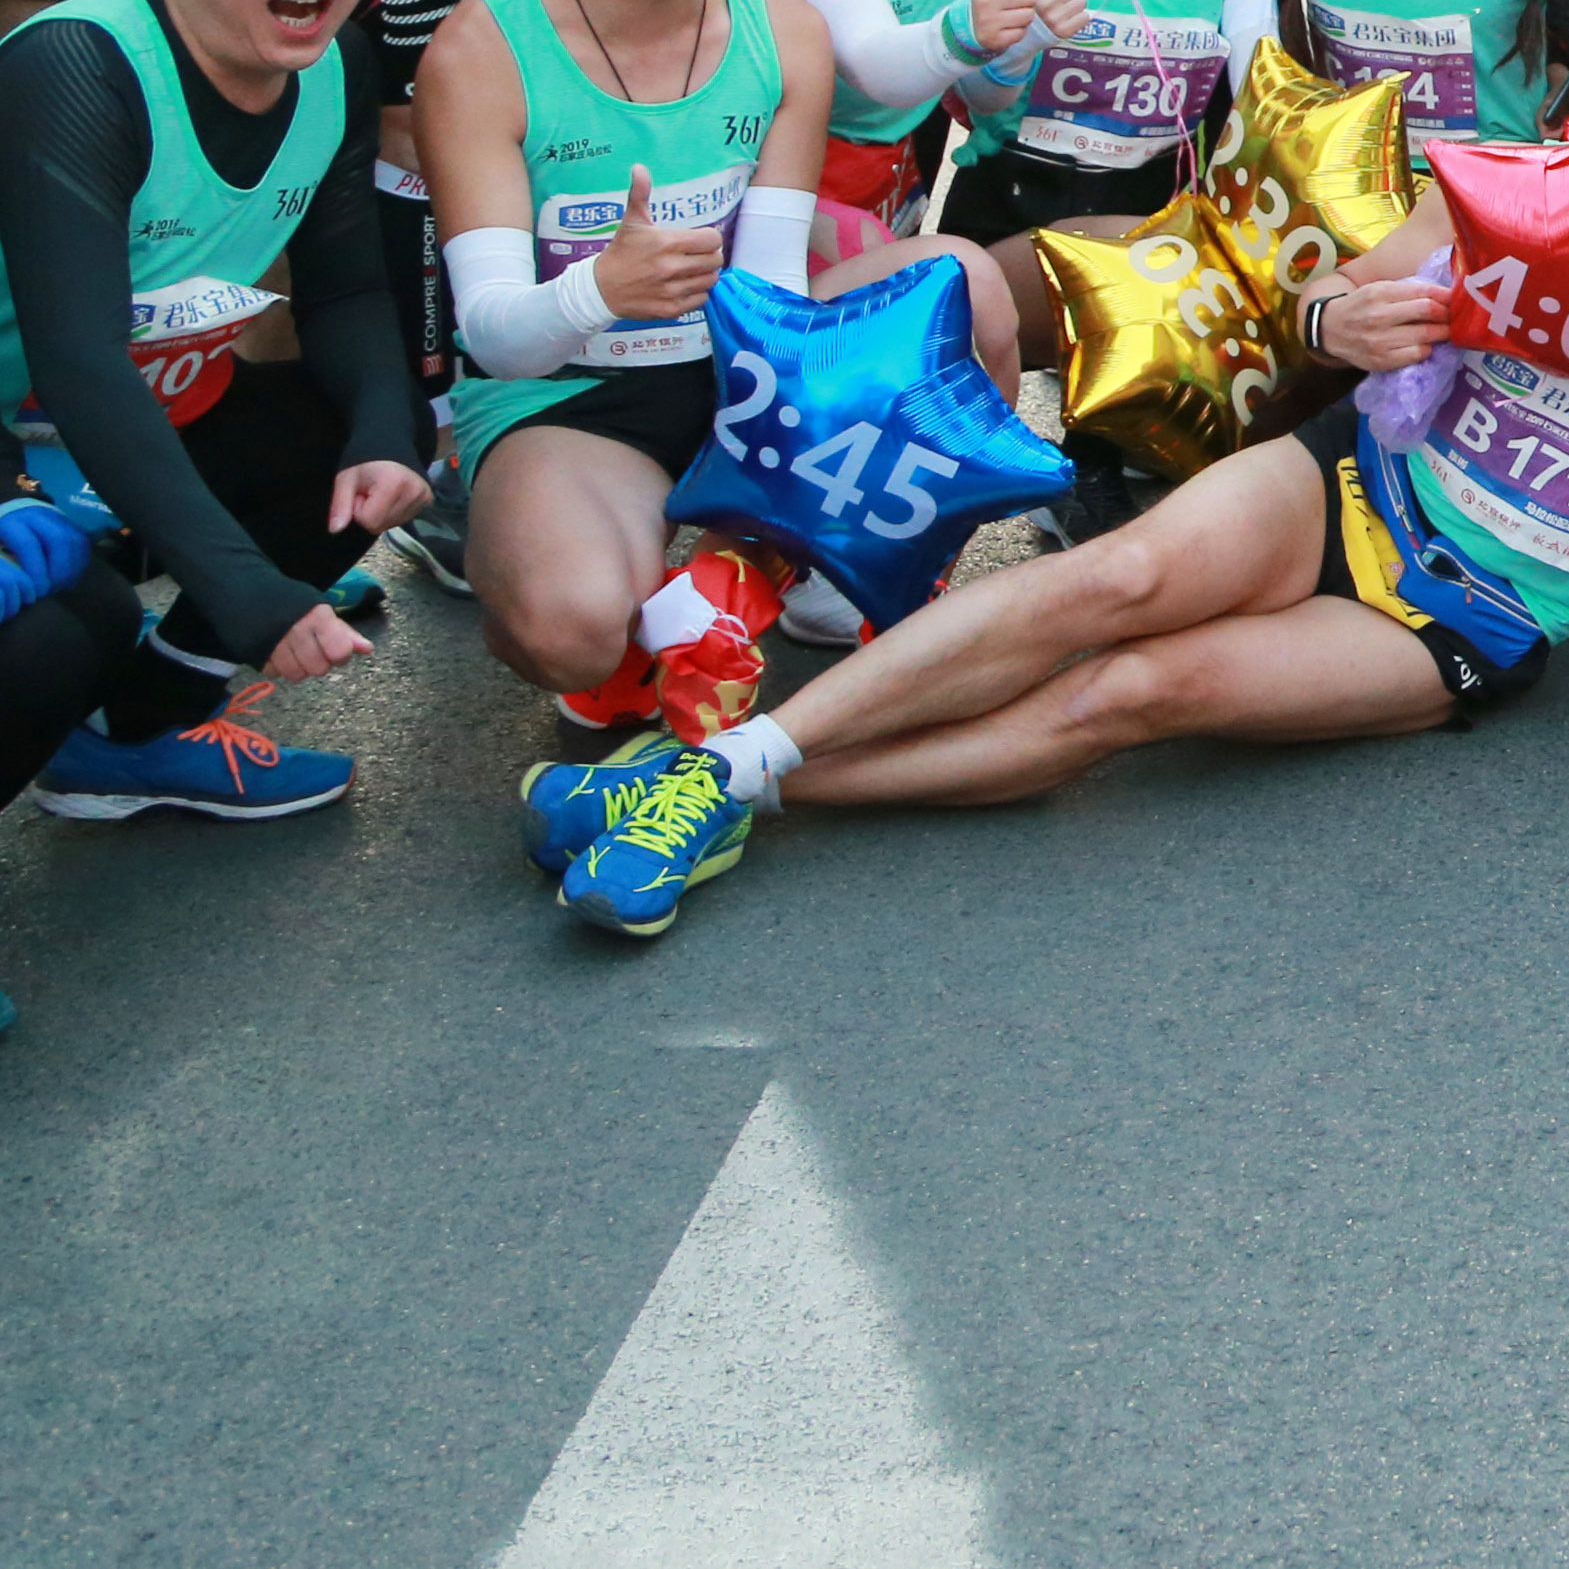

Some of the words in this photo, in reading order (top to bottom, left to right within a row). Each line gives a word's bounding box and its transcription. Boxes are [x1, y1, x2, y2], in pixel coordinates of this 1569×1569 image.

[1122, 27, 1220, 50] 君乐宝集团
[1352, 22, 1456, 47] 君乐宝集团
[1051, 67, 1092, 103] C
[1105, 73, 1187, 117] 130
[722, 112, 768, 145] 361°
[560, 139, 589, 153] 2019
[565, 205, 622, 221] 君乐宝
[1452, 397, 1499, 454] B
[713, 349, 961, 540] 2:45
